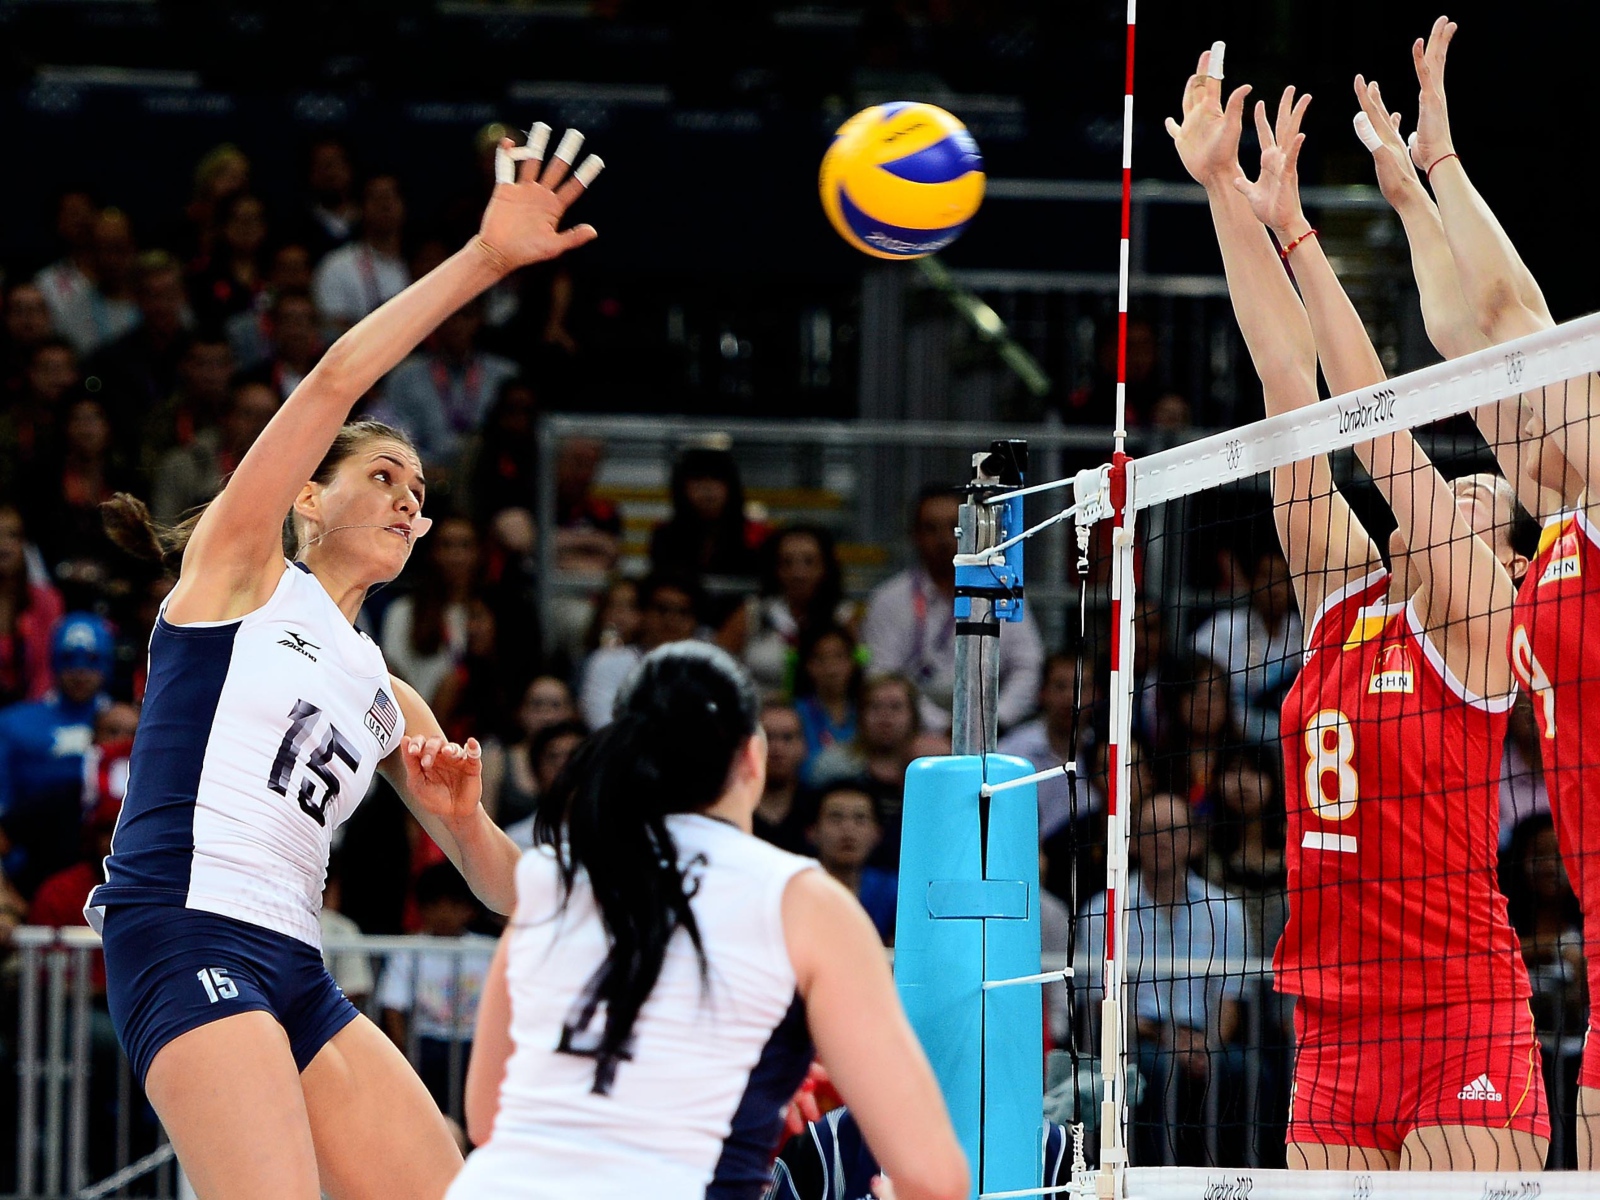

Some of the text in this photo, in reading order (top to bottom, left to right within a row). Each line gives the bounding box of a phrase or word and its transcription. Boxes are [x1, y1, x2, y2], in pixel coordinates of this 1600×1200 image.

[1373, 388, 1396, 423] 2012
[1374, 675, 1408, 689] CHN
[1512, 623, 1557, 739] 9
[368, 718, 387, 744] USA
[267, 698, 362, 828] 15
[1304, 708, 1359, 821] 8
[196, 967, 239, 1004] 15
[1456, 1090, 1503, 1102] adidas
